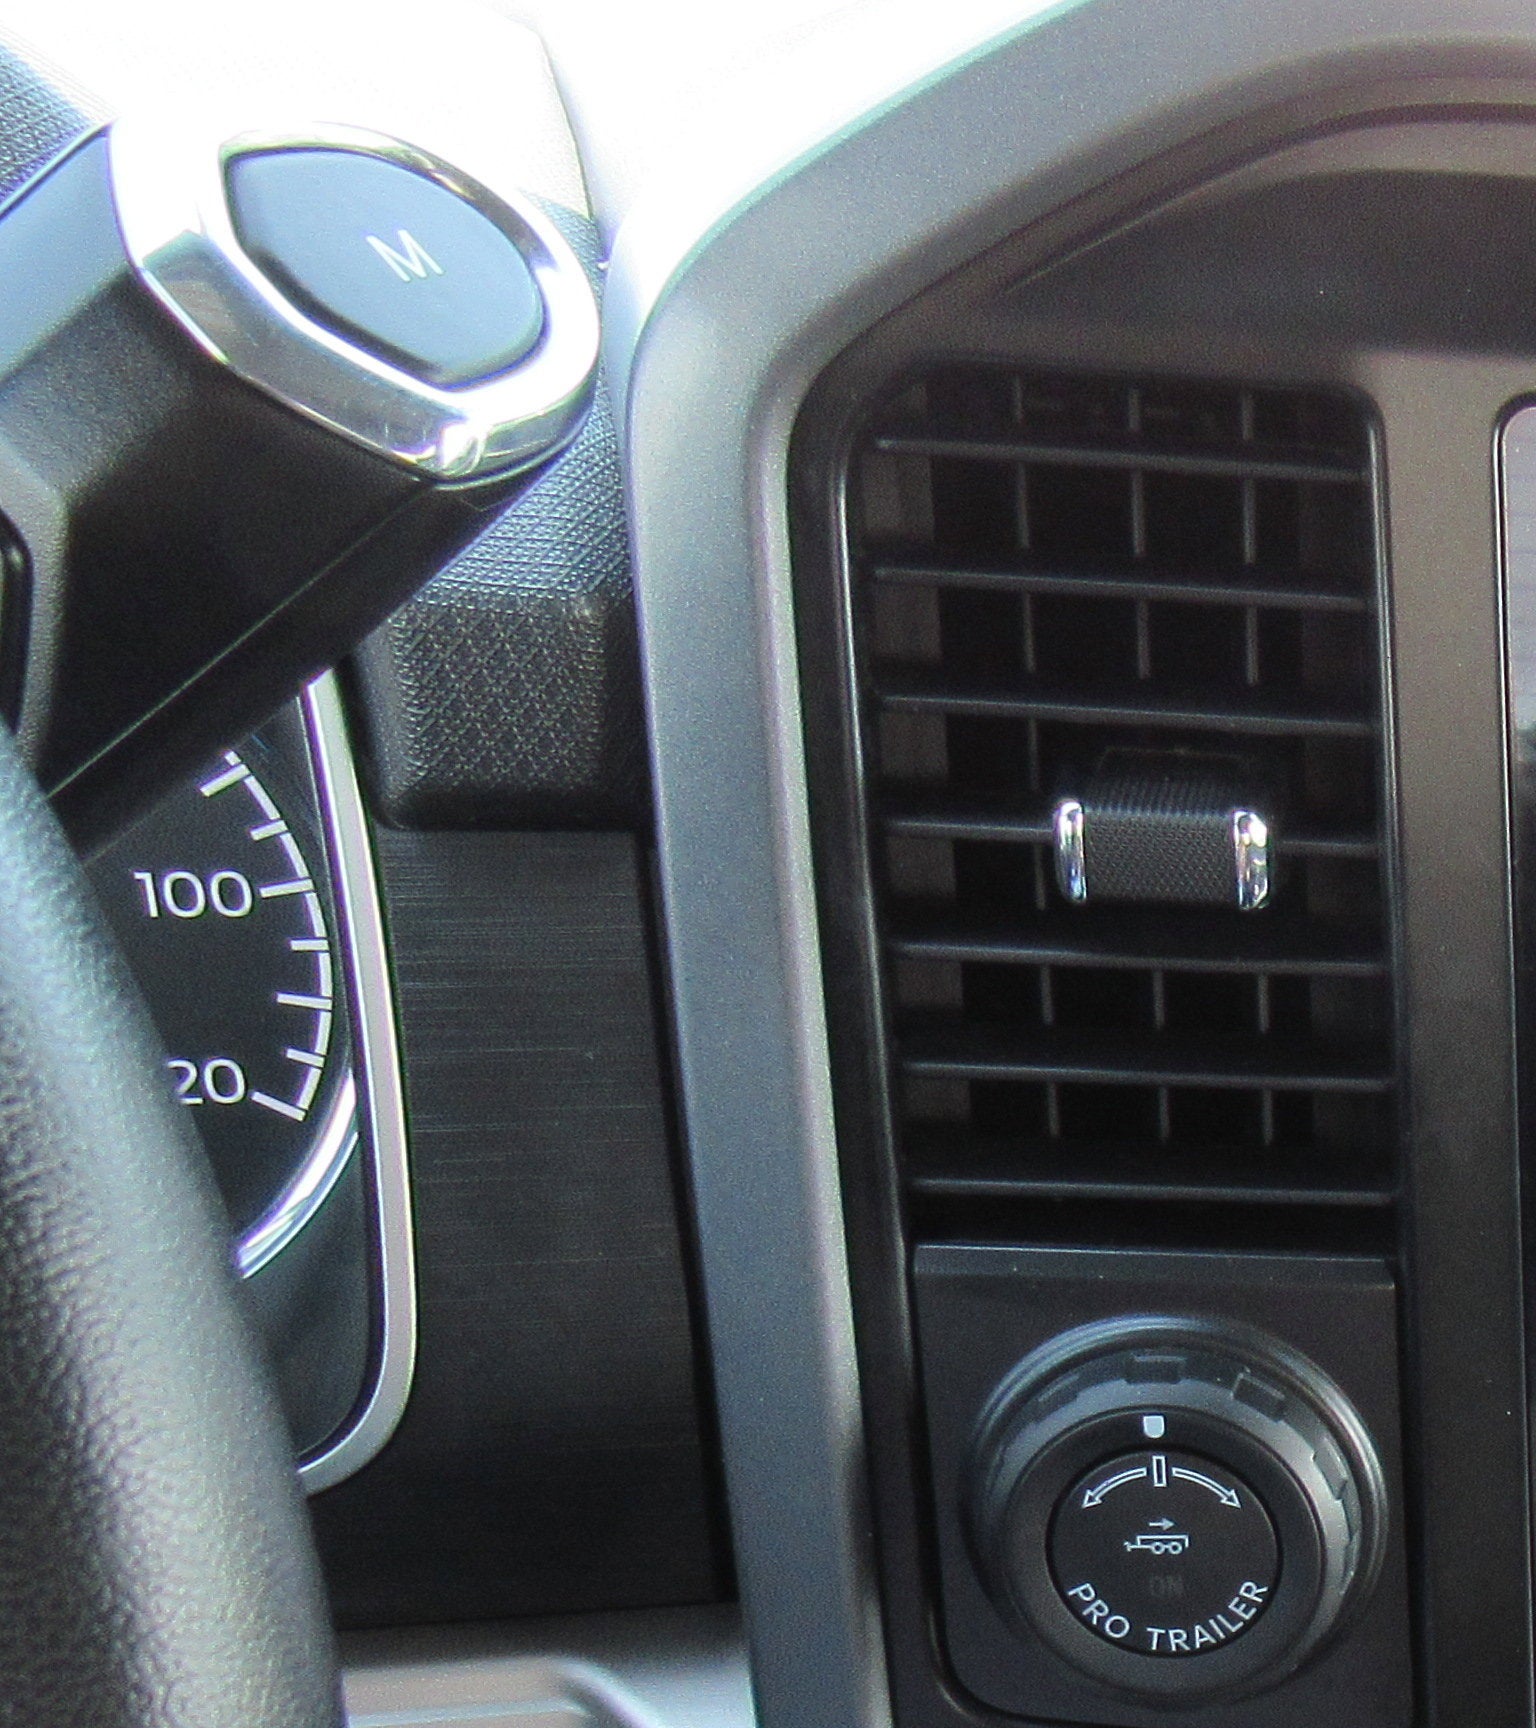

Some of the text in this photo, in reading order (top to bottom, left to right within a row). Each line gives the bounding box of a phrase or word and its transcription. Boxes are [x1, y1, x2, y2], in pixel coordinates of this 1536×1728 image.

[365, 229, 444, 283] M
[134, 869, 253, 919] 100
[166, 1057, 247, 1106] 20
[1067, 1580, 1269, 1652] PRO TRAILER
